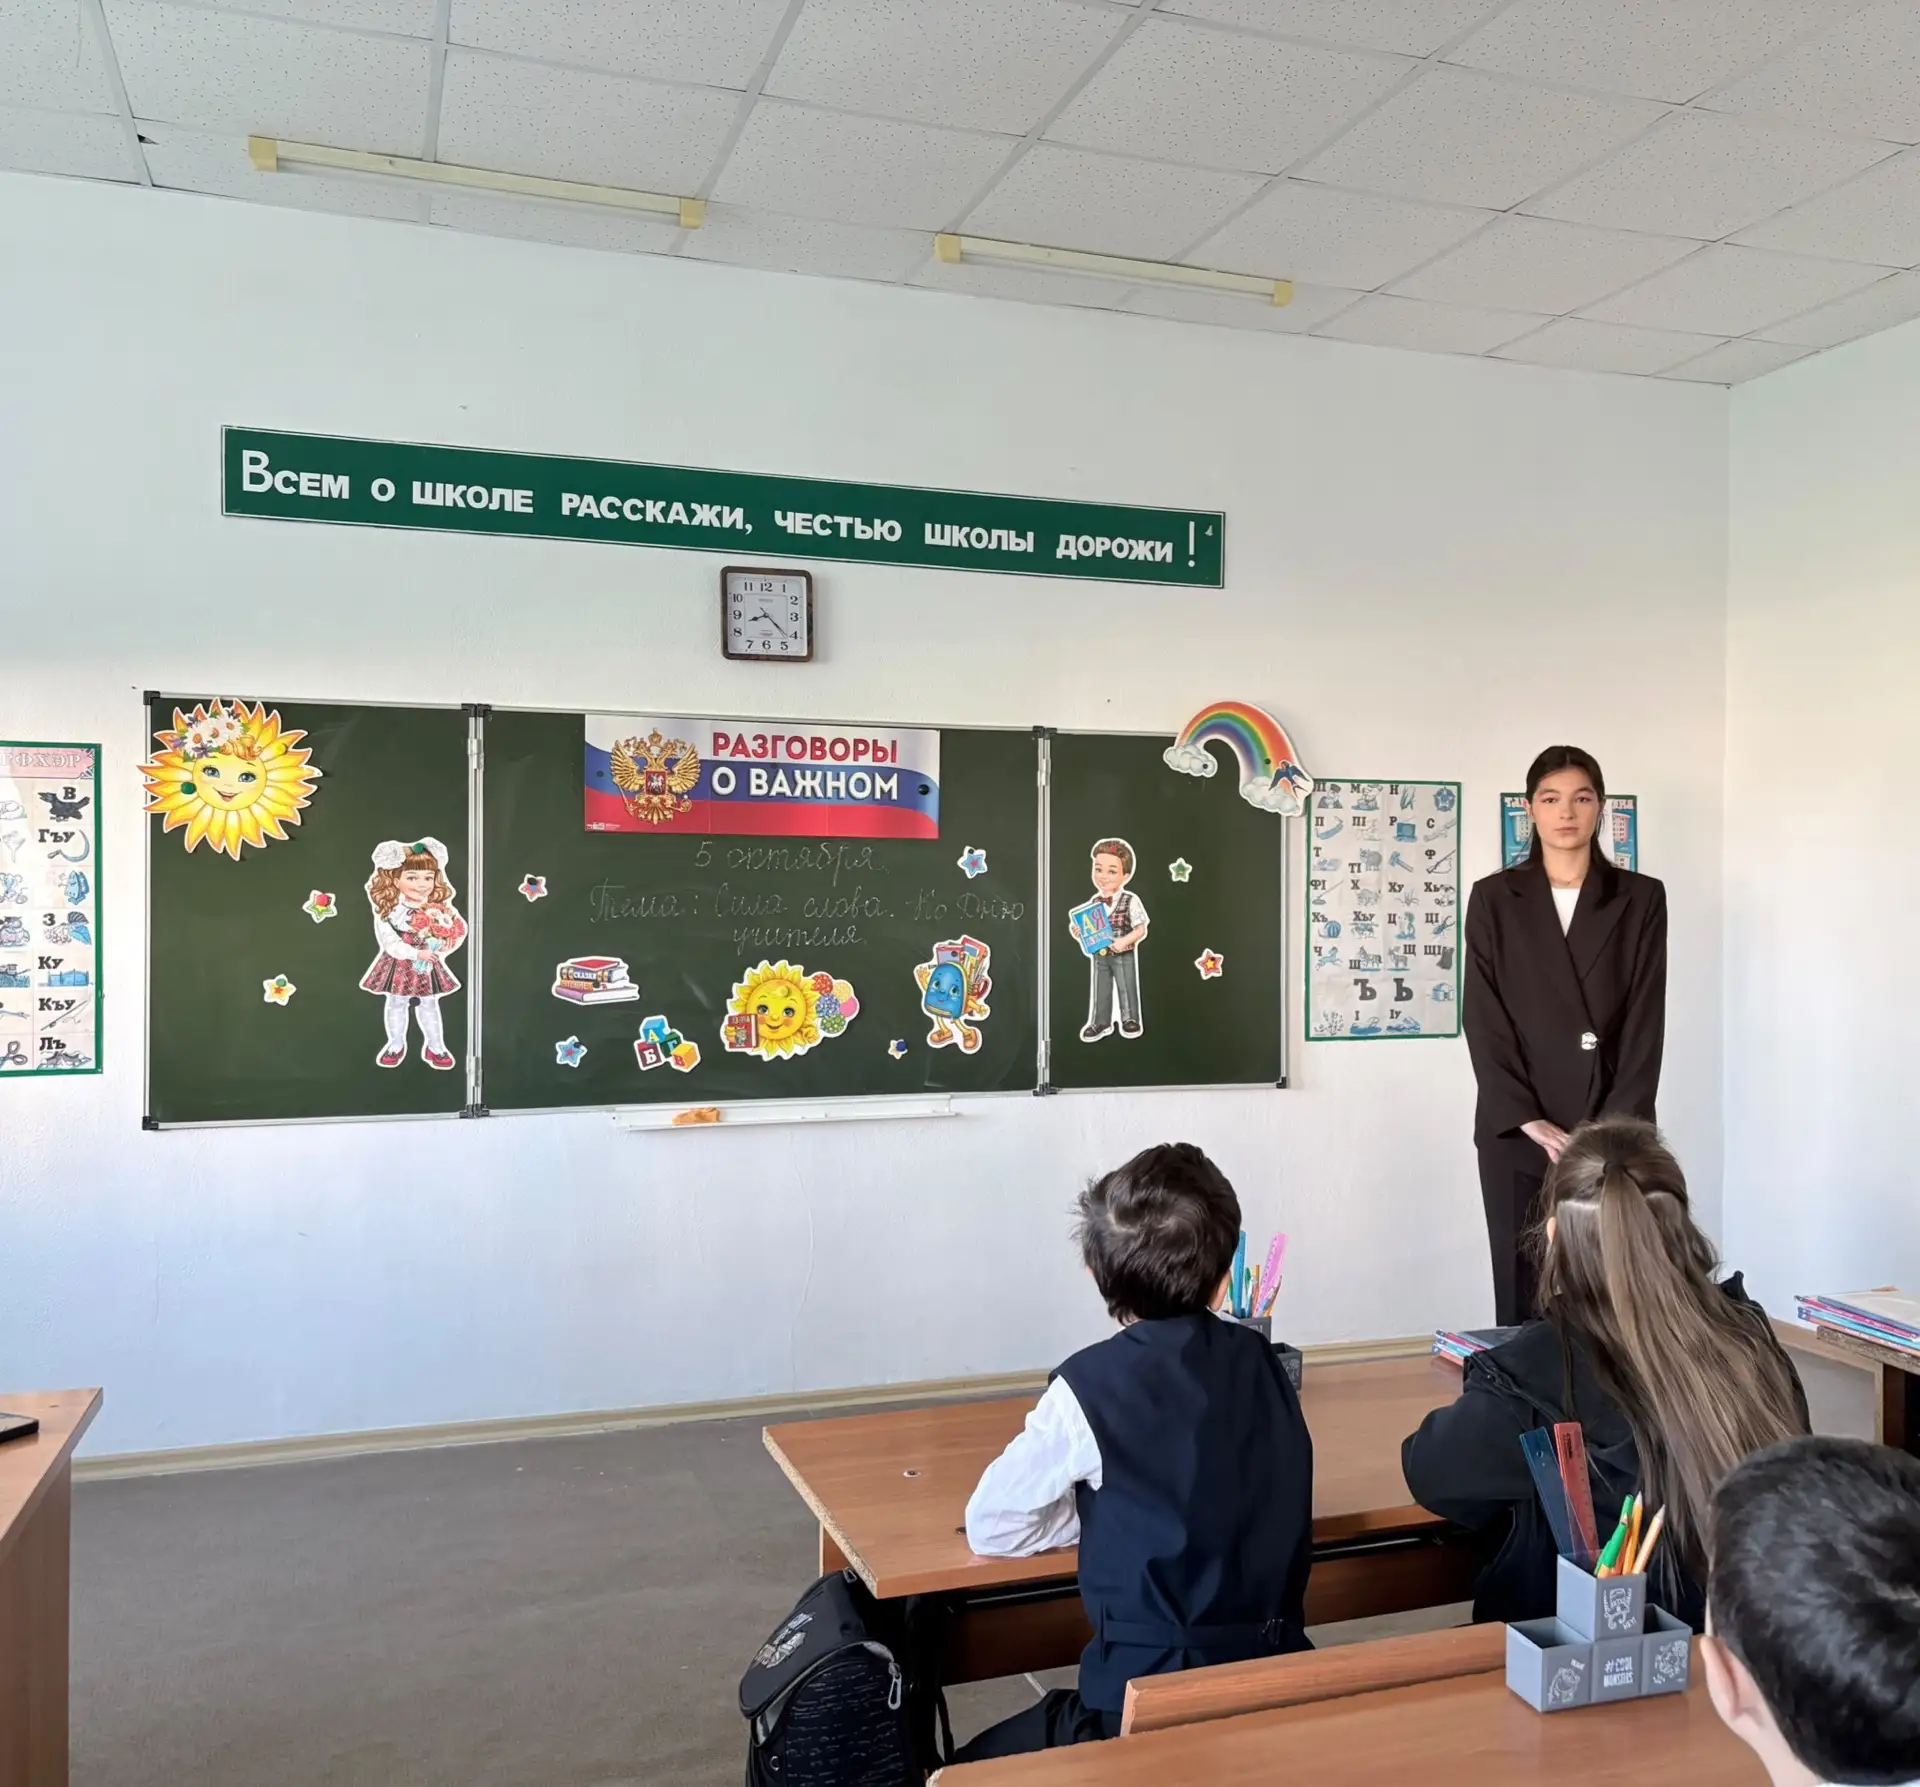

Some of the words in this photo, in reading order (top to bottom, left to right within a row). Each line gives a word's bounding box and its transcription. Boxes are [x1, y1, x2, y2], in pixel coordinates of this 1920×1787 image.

[242, 449, 350, 499] ВСЕМ
[412, 481, 534, 514] ШКОЛЕ
[561, 492, 753, 535] РАССКАЖИ,
[774, 510, 902, 542] ЧЕСТЬЮ
[924, 523, 1035, 553] ШКОЛЫ
[1056, 534, 1173, 564] ДОРОЖИ
[744, 582, 753, 592] 11
[760, 582, 773, 592] 12
[782, 584, 786, 593] 1
[733, 593, 743, 603] 10
[790, 595, 799, 606] 2
[733, 610, 742, 620] 9
[790, 612, 799, 622] 3
[733, 627, 742, 637] 8
[789, 631, 798, 640] 4
[746, 639, 754, 649] 7
[762, 640, 771, 650] 6
[780, 641, 789, 650] 5
[713, 732, 897, 763] РАЗГОВОРЫ
[712, 767, 736, 796] О
[750, 768, 898, 801] ВАЖНОМ
[1350, 783, 1361, 794] М
[1390, 784, 1399, 795] Н
[63, 786, 76, 800] В
[1315, 816, 1324, 827] П
[1389, 816, 1398, 826] Р
[1426, 818, 1435, 829] С
[38, 829, 75, 843] Гъу
[694, 841, 713, 867] 5
[1313, 847, 1322, 857] Т
[1425, 849, 1436, 860] Ф
[1351, 879, 1361, 890] Х
[1388, 882, 1404, 893] Ху
[1353, 911, 1375, 922] Хъу
[1387, 914, 1397, 926] Ц
[1313, 946, 1323, 957] Ч
[38, 956, 64, 970] Ку
[1349, 959, 1361, 970] Ш
[1353, 978, 1377, 1002] Ъ
[1393, 977, 1414, 1002] Ь
[38, 998, 76, 1011] Къу
[646, 1029, 660, 1044] А
[39, 1037, 67, 1051] Лъ
[643, 1048, 657, 1064] Б
